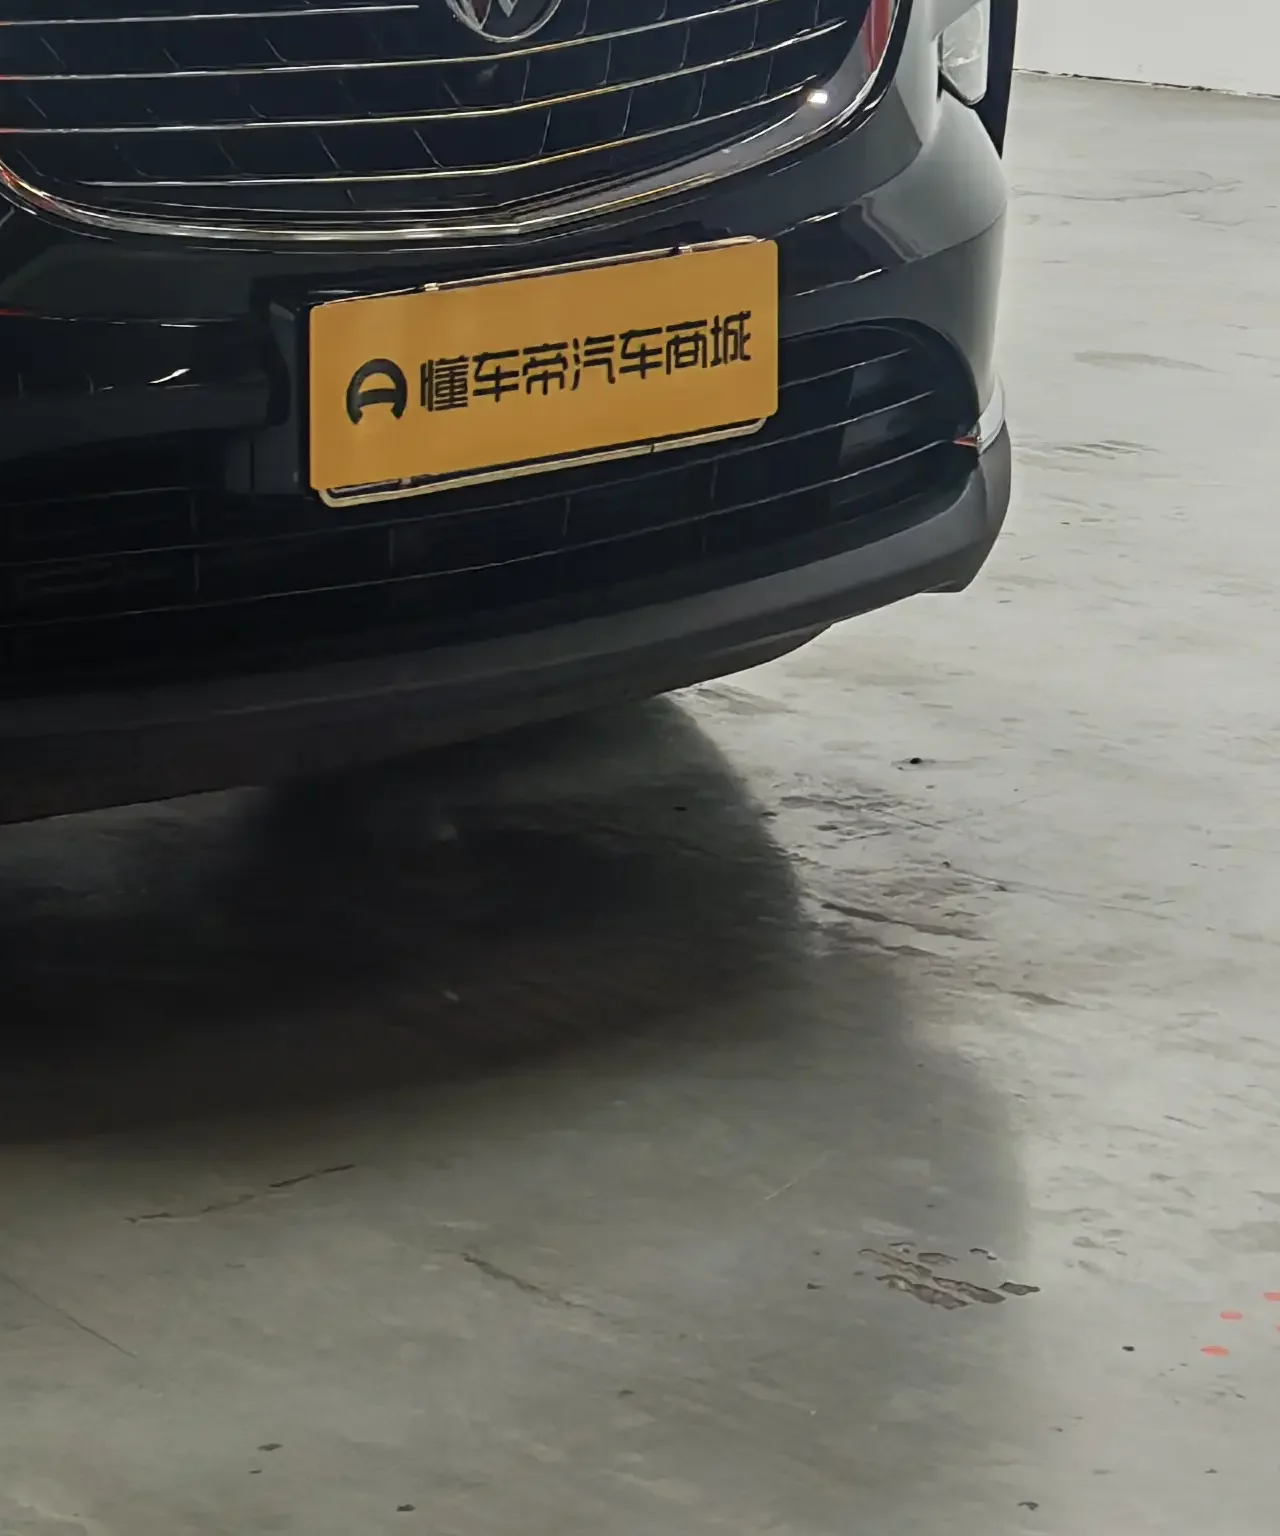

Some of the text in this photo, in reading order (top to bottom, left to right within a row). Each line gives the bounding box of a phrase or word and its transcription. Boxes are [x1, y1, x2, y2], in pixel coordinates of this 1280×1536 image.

[420, 310, 752, 413] 懂车帝汽车商城
